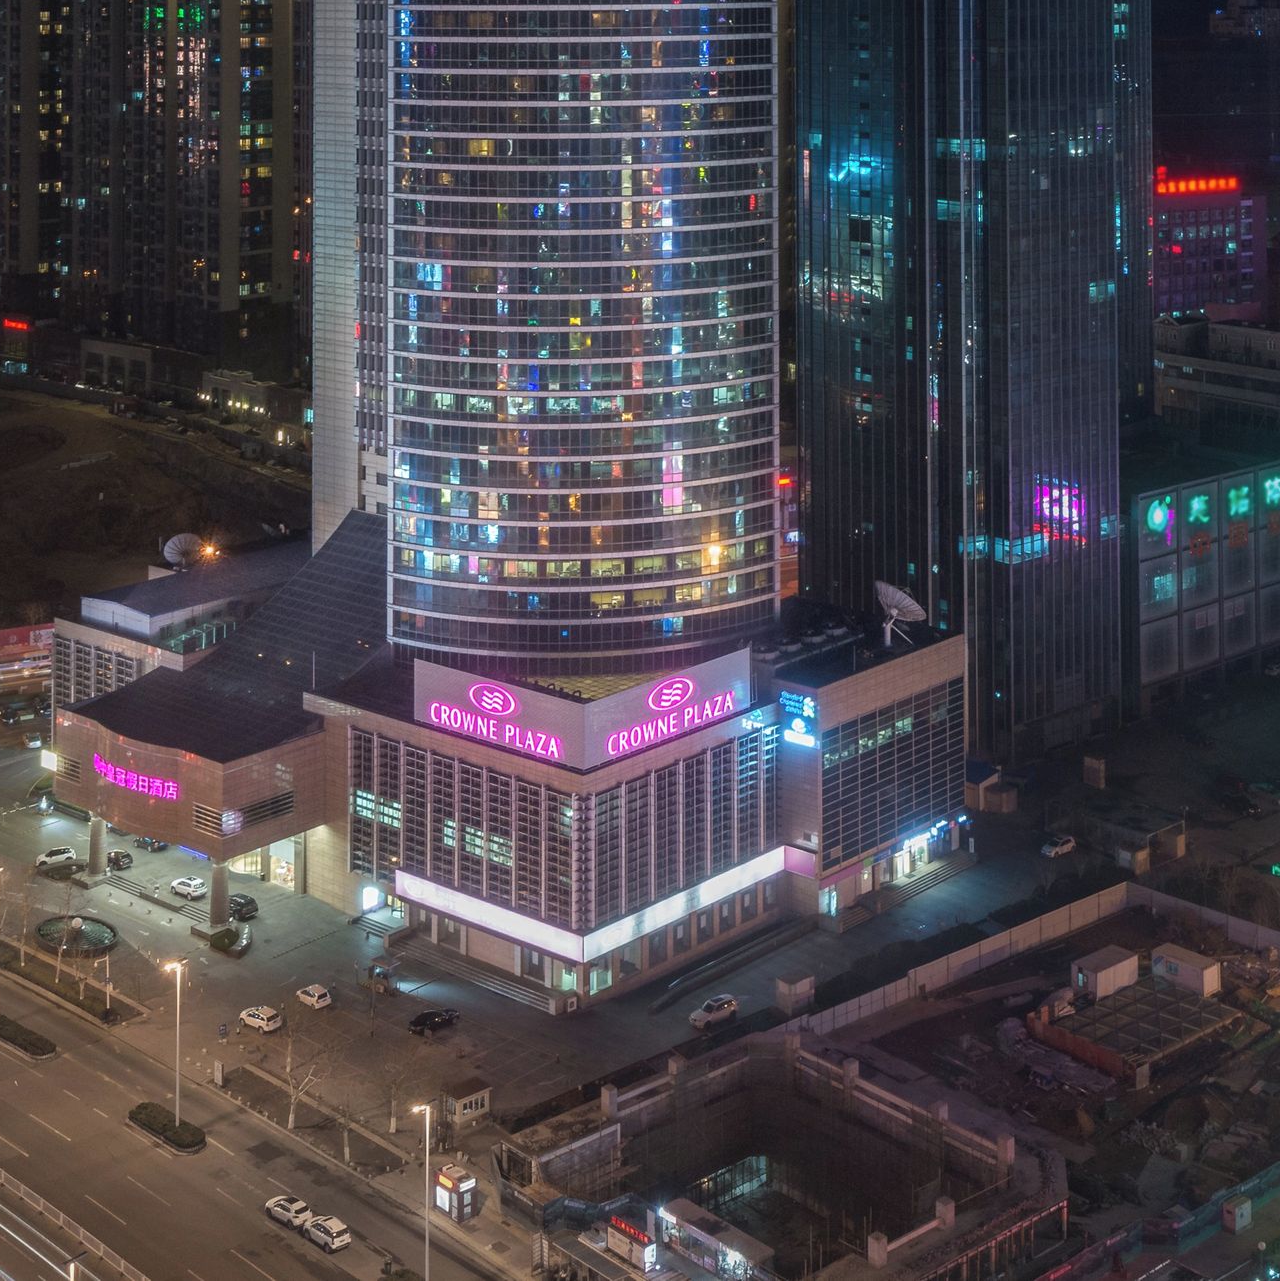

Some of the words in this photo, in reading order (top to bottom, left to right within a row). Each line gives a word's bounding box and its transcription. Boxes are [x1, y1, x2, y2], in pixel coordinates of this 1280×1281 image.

[430, 703, 498, 740] CROWNE
[505, 726, 560, 759] PLAZA
[607, 712, 678, 755] CROWNE
[683, 694, 734, 728] PLAZA
